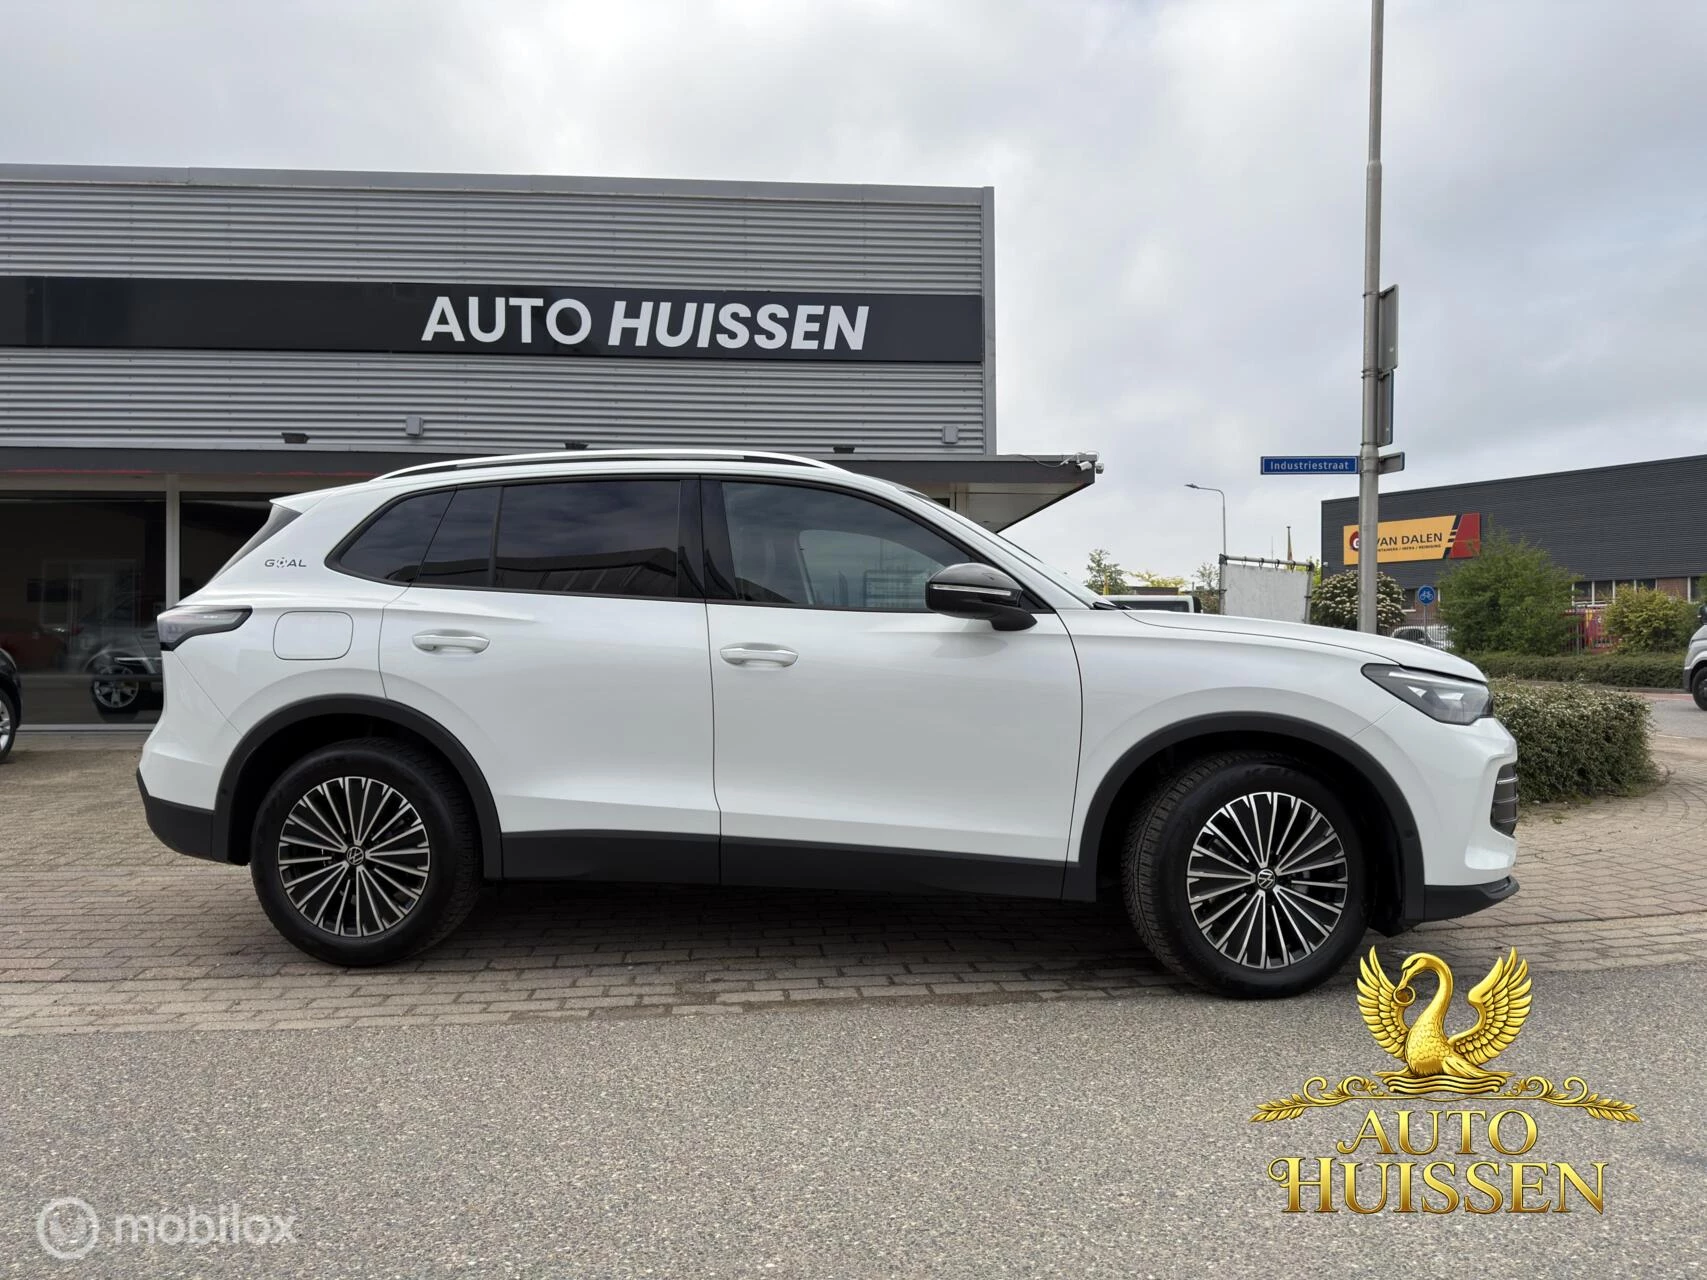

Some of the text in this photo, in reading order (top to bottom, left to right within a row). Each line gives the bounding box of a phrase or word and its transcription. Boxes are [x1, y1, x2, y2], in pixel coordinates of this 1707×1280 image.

[421, 296, 869, 351] AUTO HUISSEN
[1270, 461, 1349, 470] Industriestraat
[1401, 532, 1443, 545] DALEN
[264, 557, 307, 568] GOAL
